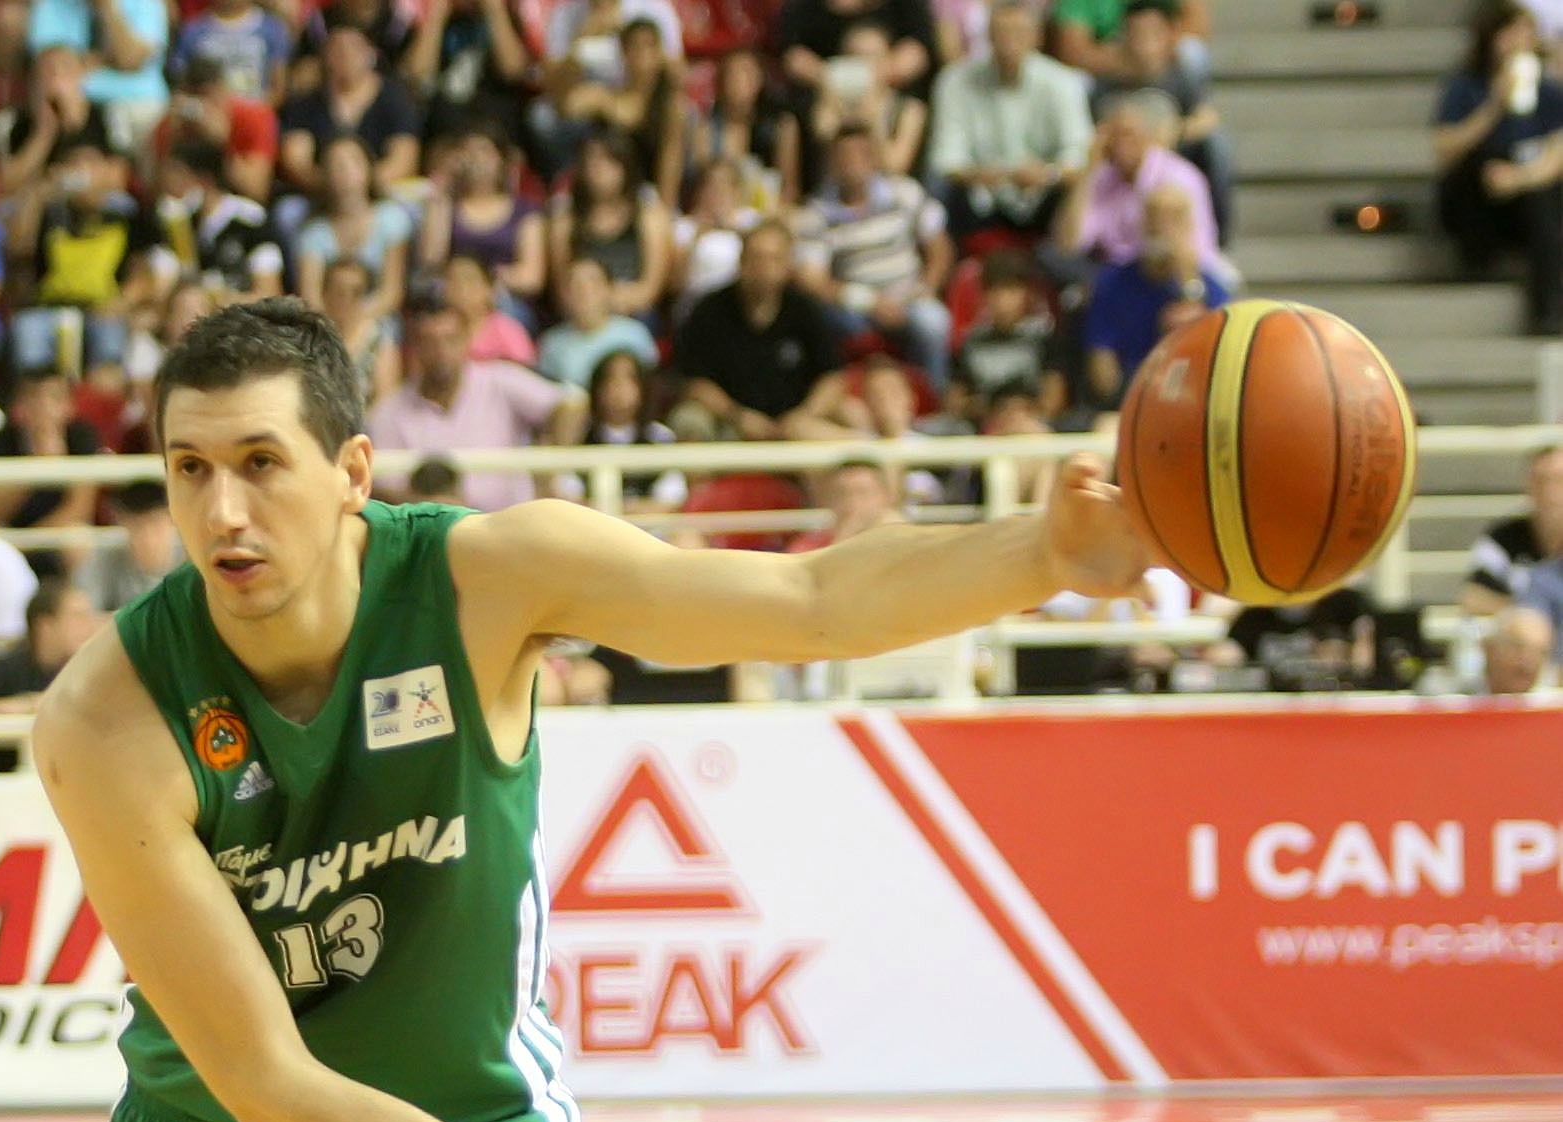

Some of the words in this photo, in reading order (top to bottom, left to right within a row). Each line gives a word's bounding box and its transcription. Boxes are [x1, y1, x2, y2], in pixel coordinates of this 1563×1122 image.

[1190, 823, 1217, 896] I
[1245, 821, 1465, 900] CAN
[1492, 820, 1563, 898] P
[273, 892, 385, 989] 13
